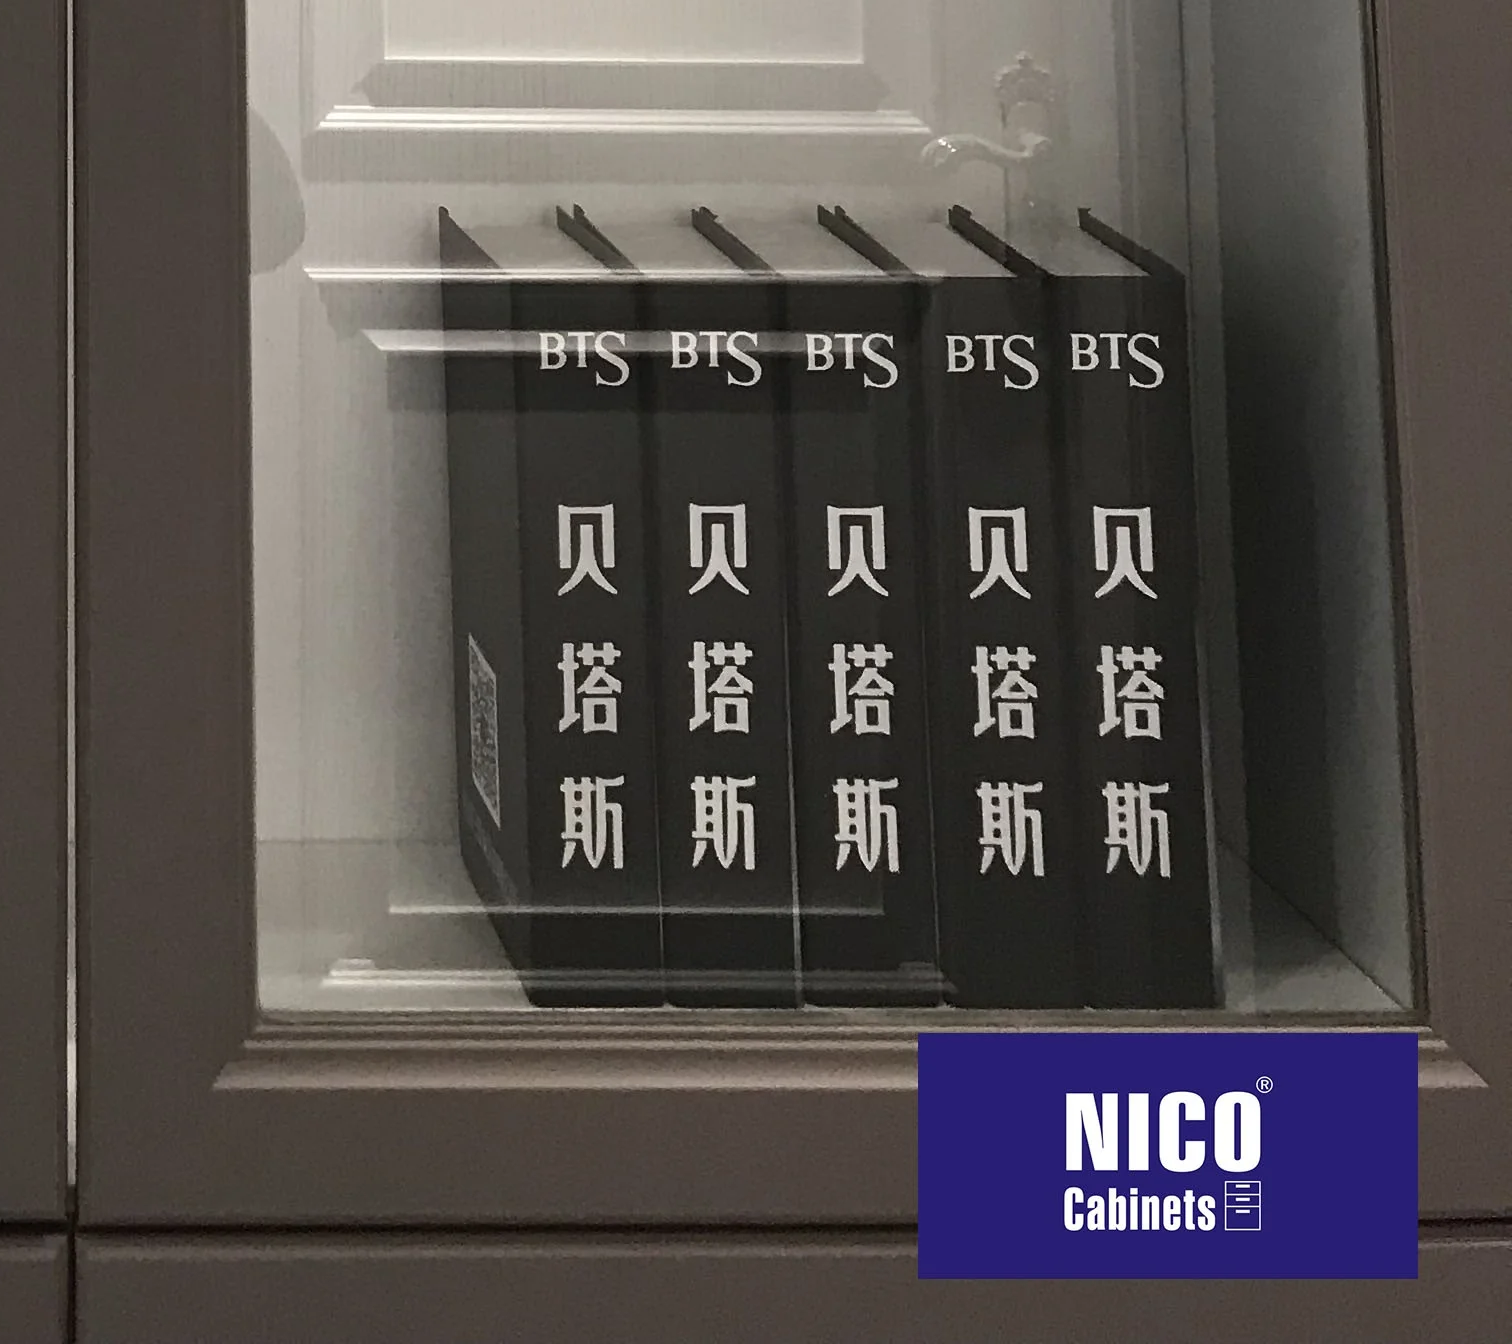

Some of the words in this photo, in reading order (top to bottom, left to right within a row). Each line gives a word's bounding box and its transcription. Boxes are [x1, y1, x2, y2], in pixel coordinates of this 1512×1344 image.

[539, 331, 630, 387] BTS
[671, 331, 763, 387] BTS
[806, 334, 899, 389] BTS
[946, 334, 1040, 390] BTS
[1071, 332, 1165, 389] BTS
[557, 503, 625, 870] 贝塔斯
[688, 502, 756, 871] 贝塔斯
[827, 505, 900, 873] 贝塔斯
[968, 506, 1045, 877] 贝塔斯
[1093, 505, 1171, 878] 贝塔斯
